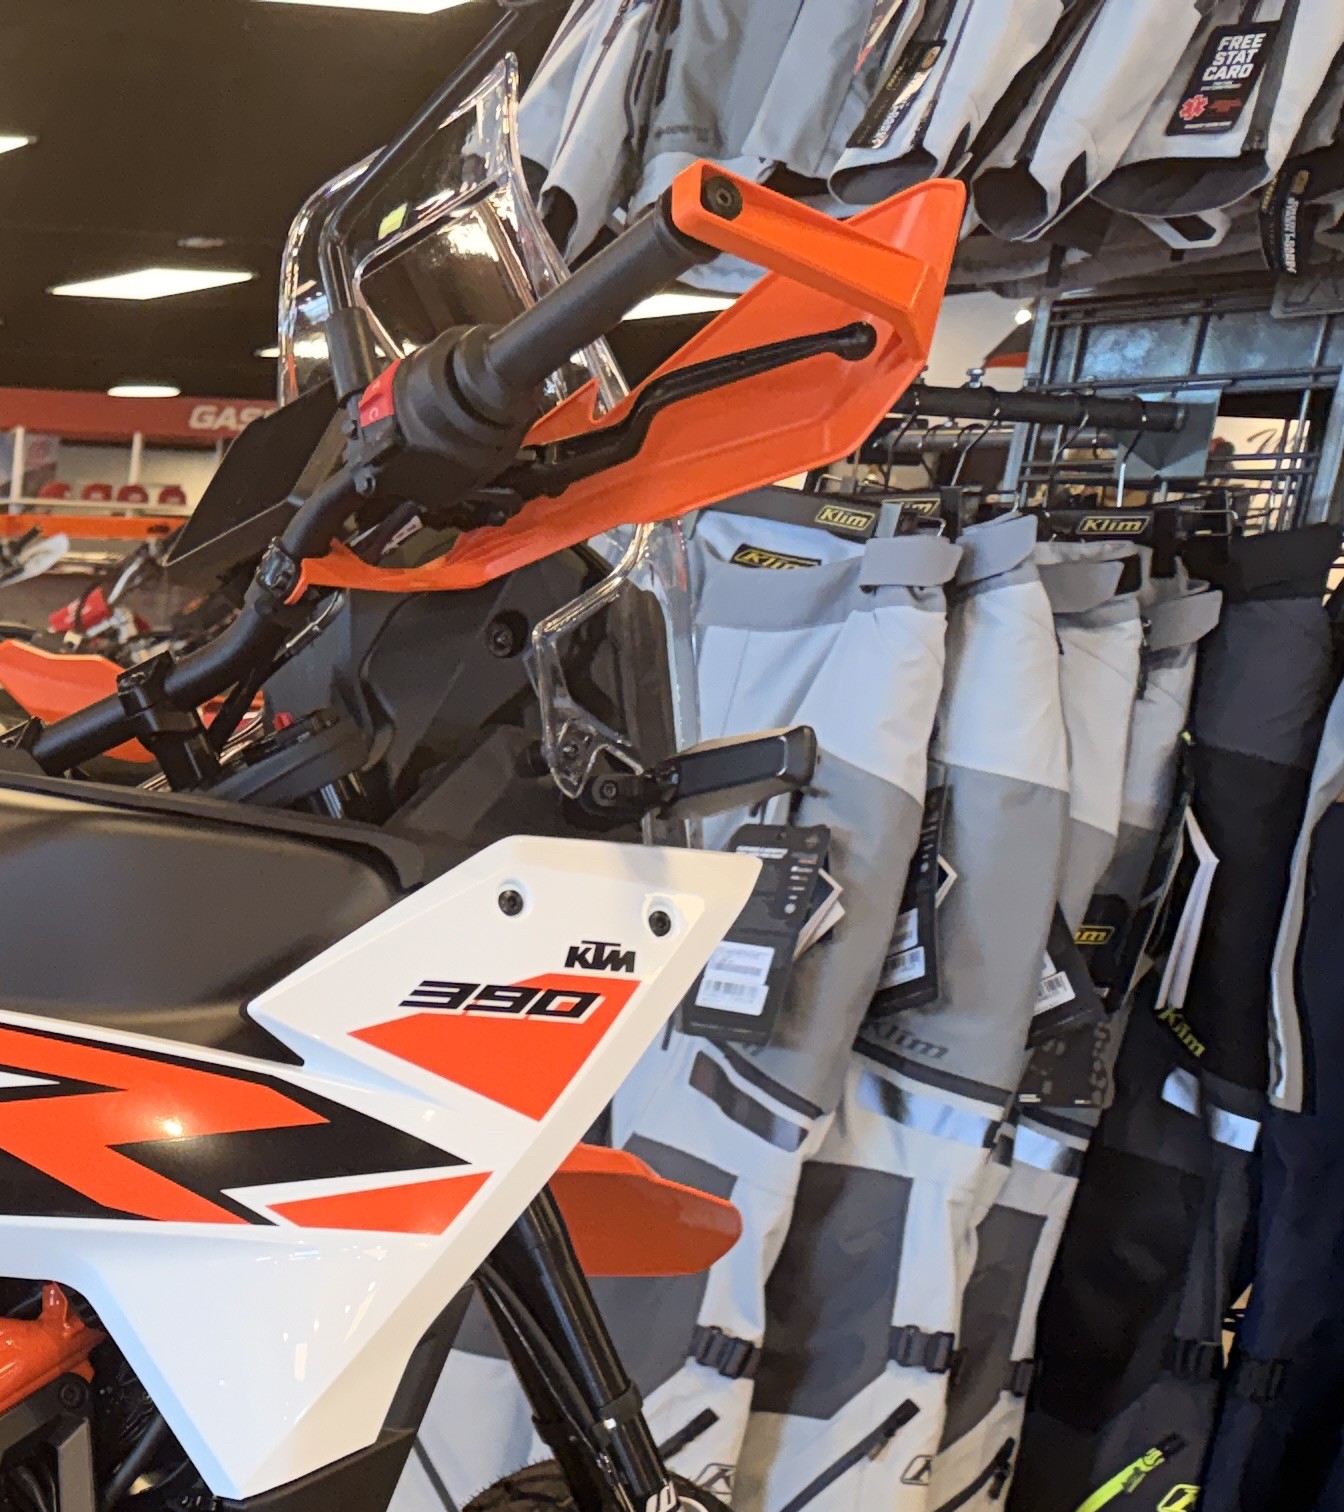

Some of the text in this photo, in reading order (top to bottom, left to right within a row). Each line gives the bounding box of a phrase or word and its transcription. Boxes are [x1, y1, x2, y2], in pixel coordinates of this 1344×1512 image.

[1217, 33, 1267, 51] FREE
[1212, 48, 1259, 66] STAT
[1201, 63, 1254, 82] CARD
[188, 404, 275, 432] GAS
[822, 508, 872, 529] Klim
[1081, 517, 1144, 533] Klim
[564, 939, 636, 974] KTM
[398, 979, 602, 1020] 390
